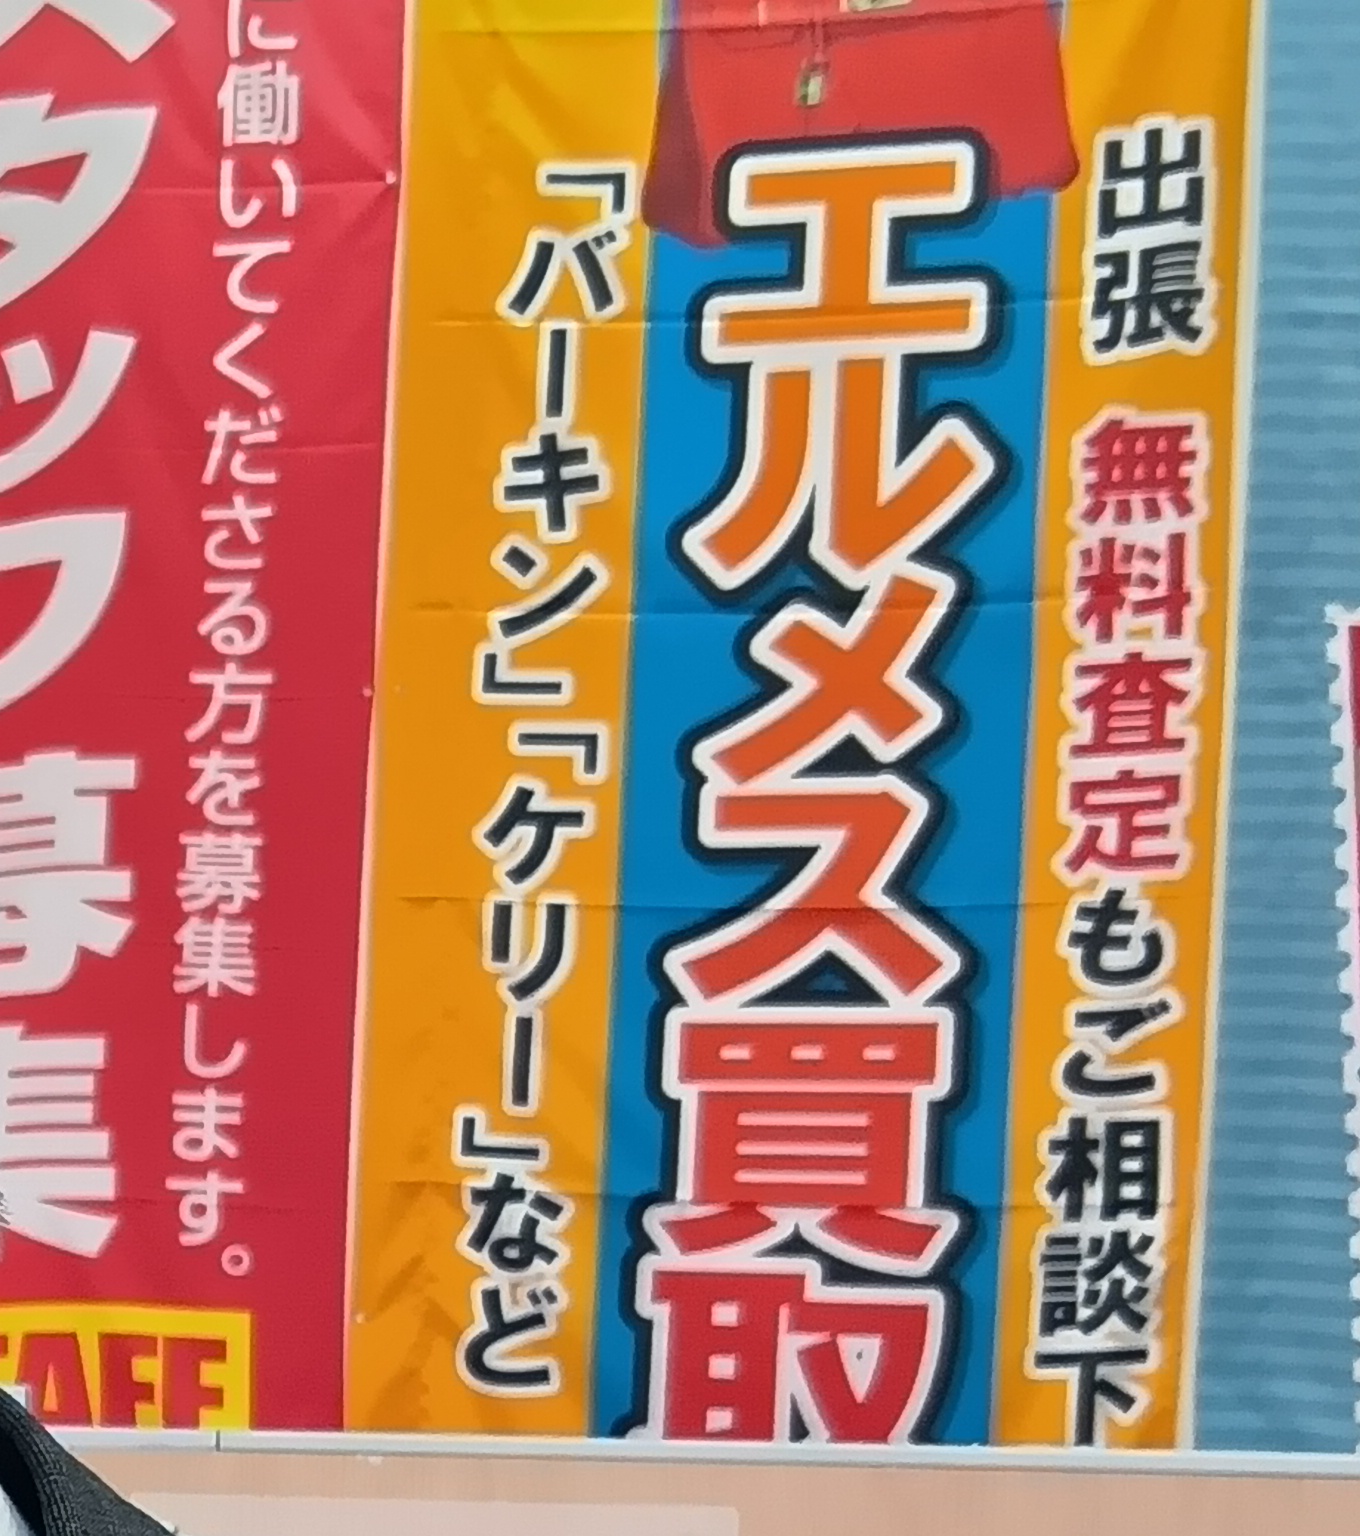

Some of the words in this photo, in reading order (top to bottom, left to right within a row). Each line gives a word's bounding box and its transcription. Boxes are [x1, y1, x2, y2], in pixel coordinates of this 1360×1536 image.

[166, 0, 300, 1277] に働いてくださる方を募集します。
[638, 142, 996, 1441] エルメス買取
[1090, 127, 1206, 354] 出張
